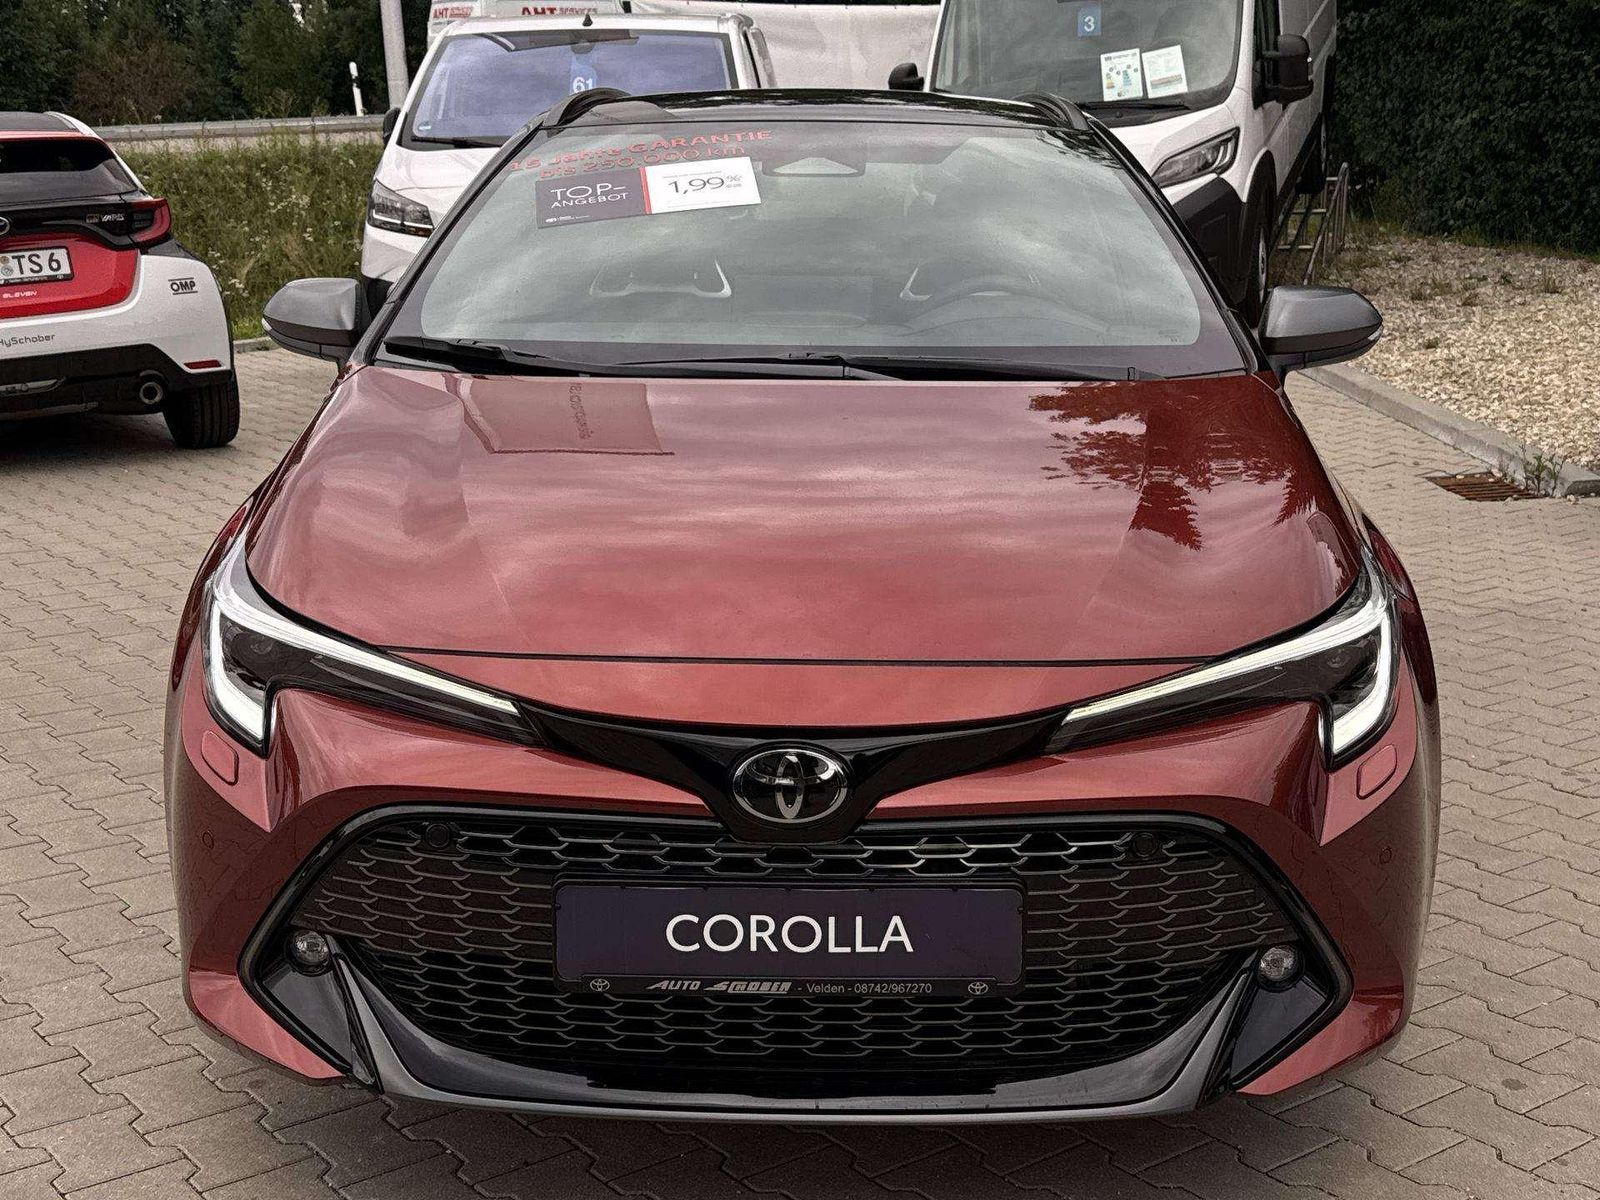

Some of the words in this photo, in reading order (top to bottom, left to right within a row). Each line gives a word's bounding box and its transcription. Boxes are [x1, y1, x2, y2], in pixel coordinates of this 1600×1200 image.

[1084, 16, 1095, 32] 3
[573, 77, 593, 93] 61
[626, 130, 772, 153] GARANTIE
[550, 183, 626, 201] TOP-
[668, 176, 725, 195] 1,99
[551, 192, 629, 209] ANGEBOT
[11, 253, 43, 275] TS
[47, 252, 62, 272] 6
[170, 280, 196, 292] OMP
[665, 913, 914, 953] COROLLA
[645, 980, 701, 991] AUTO
[806, 983, 845, 993] Velden
[853, 983, 933, 994] 08742/967270
